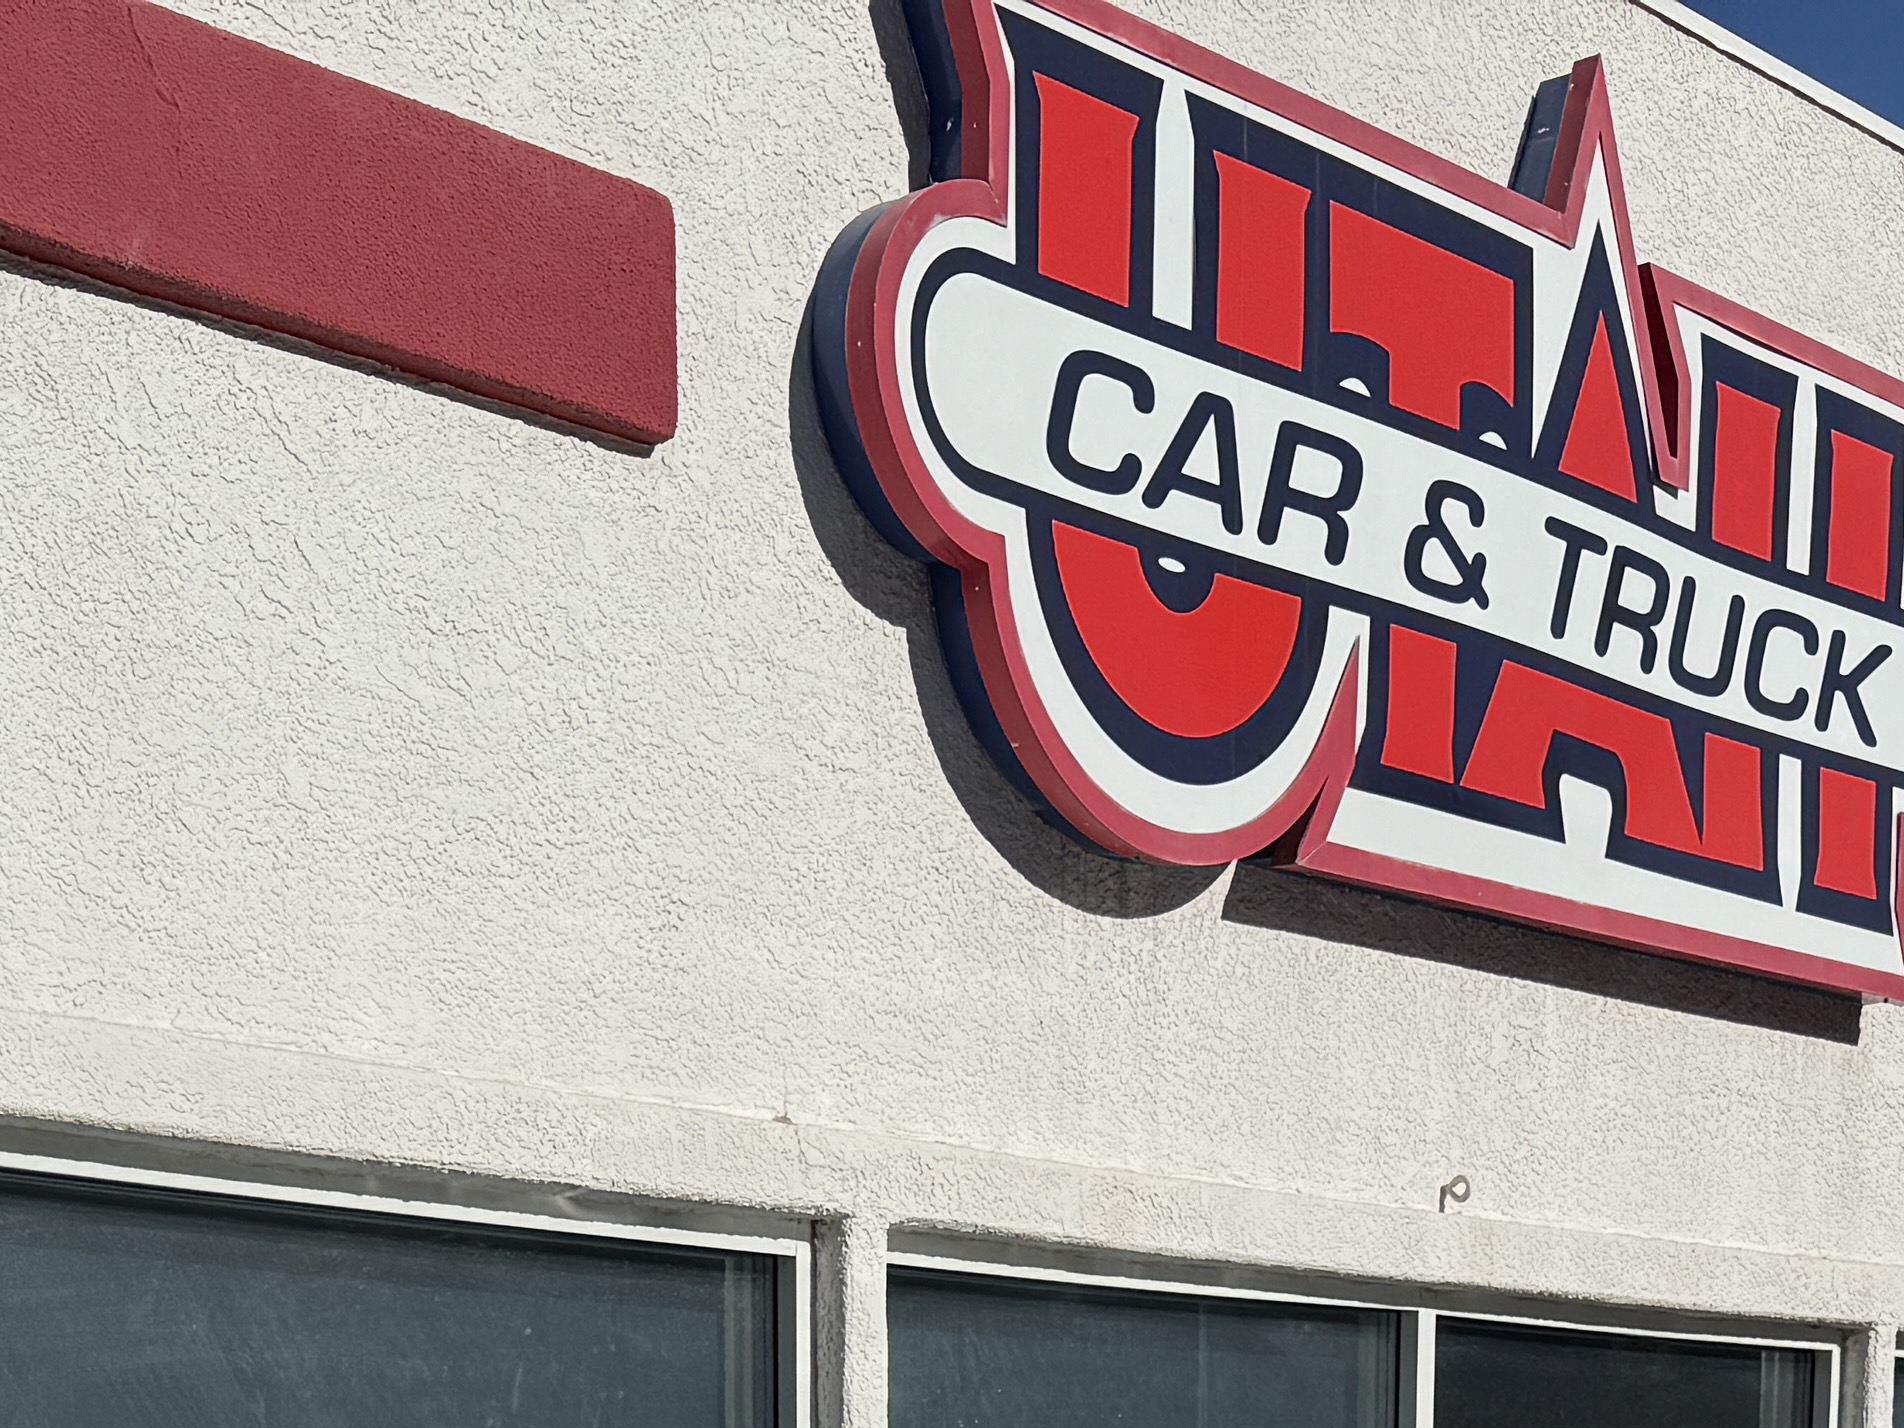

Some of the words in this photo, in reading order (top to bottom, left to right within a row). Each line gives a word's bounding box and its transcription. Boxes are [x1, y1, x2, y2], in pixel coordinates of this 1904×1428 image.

[1045, 349, 1364, 566] CAR
[1404, 479, 1491, 611] &
[1543, 516, 1893, 748] TRUCK
